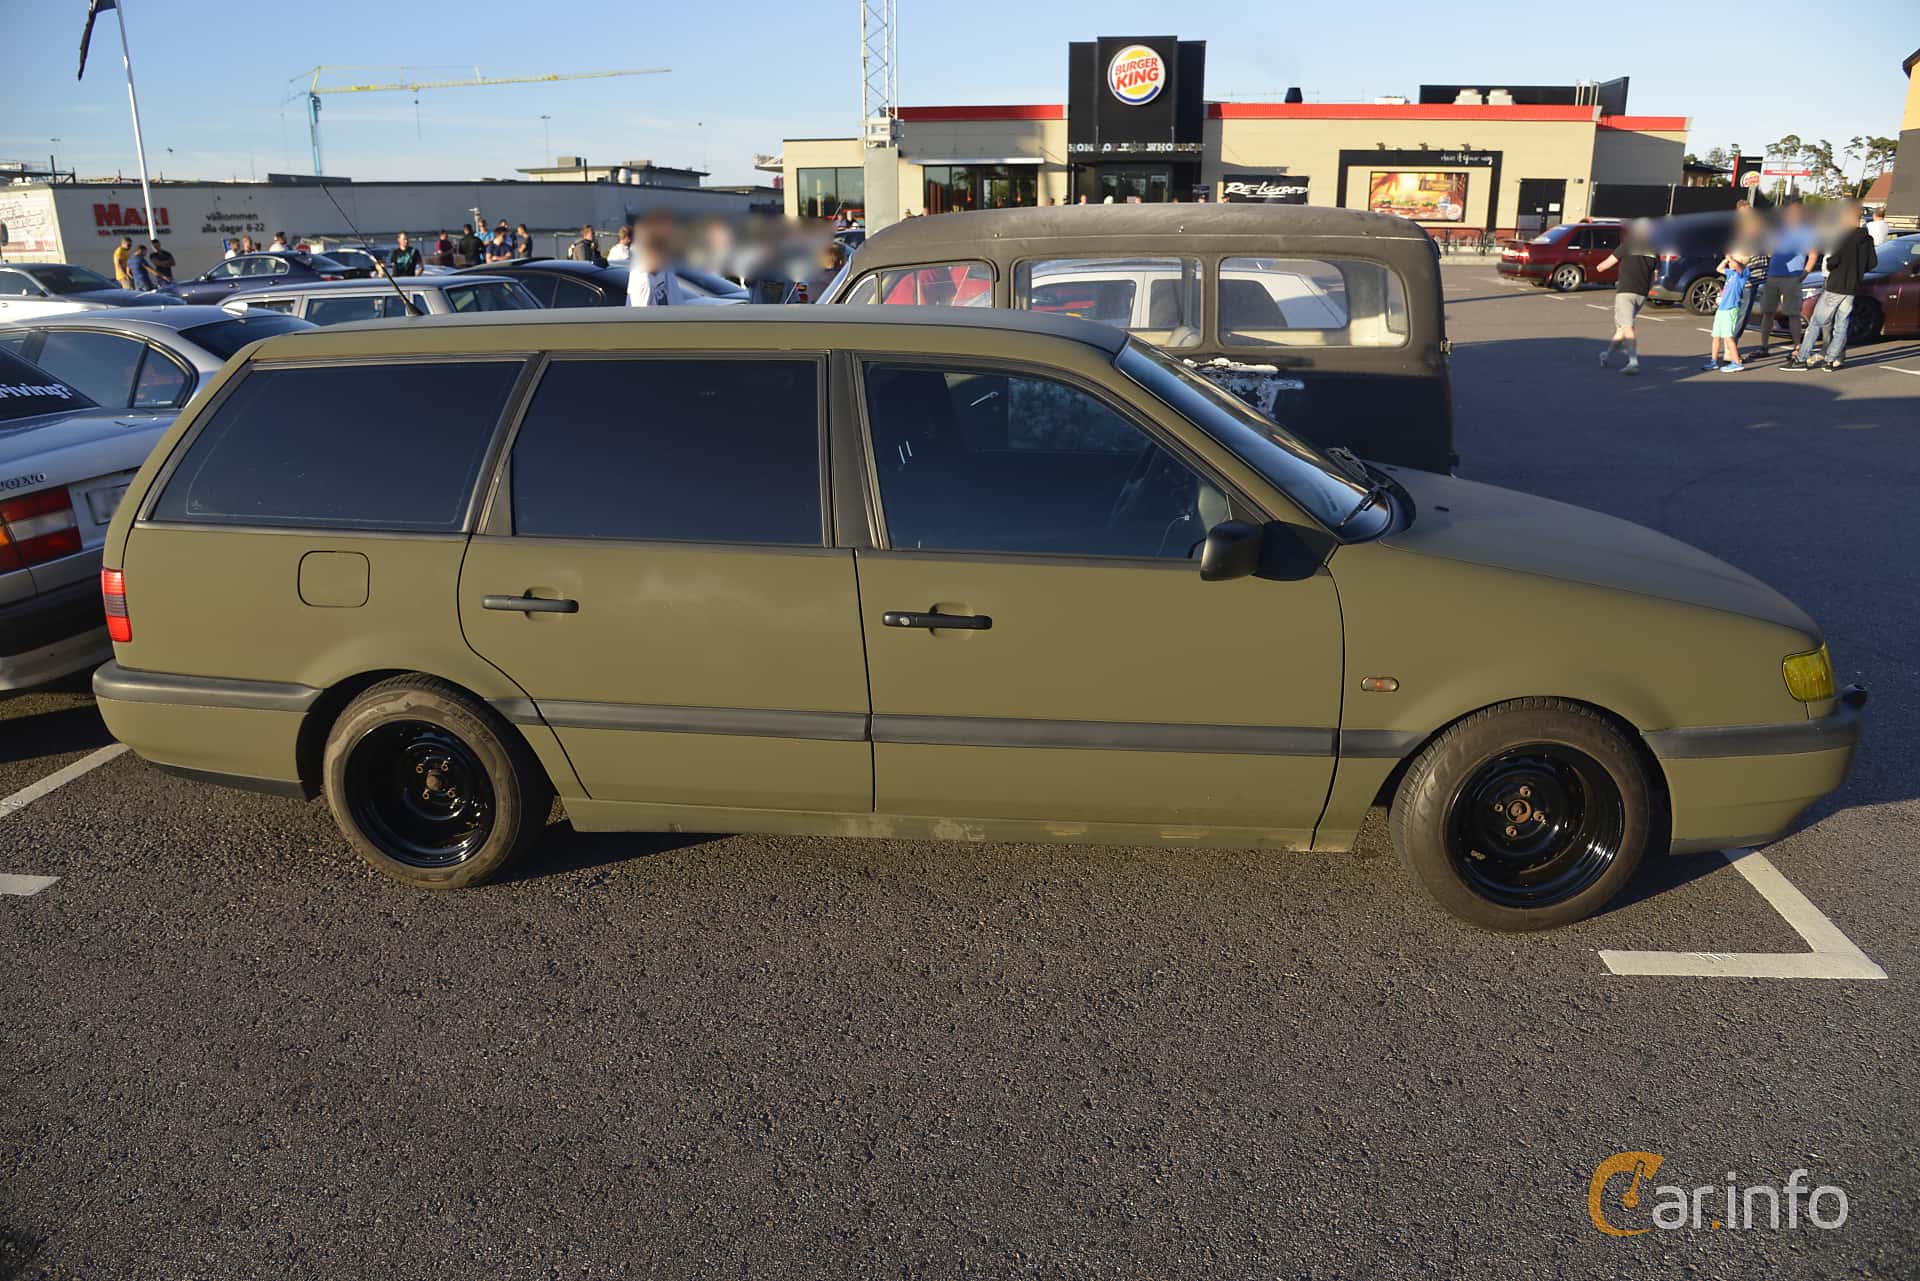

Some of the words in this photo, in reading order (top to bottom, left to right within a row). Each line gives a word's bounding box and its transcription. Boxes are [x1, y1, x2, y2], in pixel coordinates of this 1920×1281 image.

[1115, 58, 1158, 76] BURGER
[1115, 68, 1159, 91] KING
[0, 383, 72, 399] riving?
